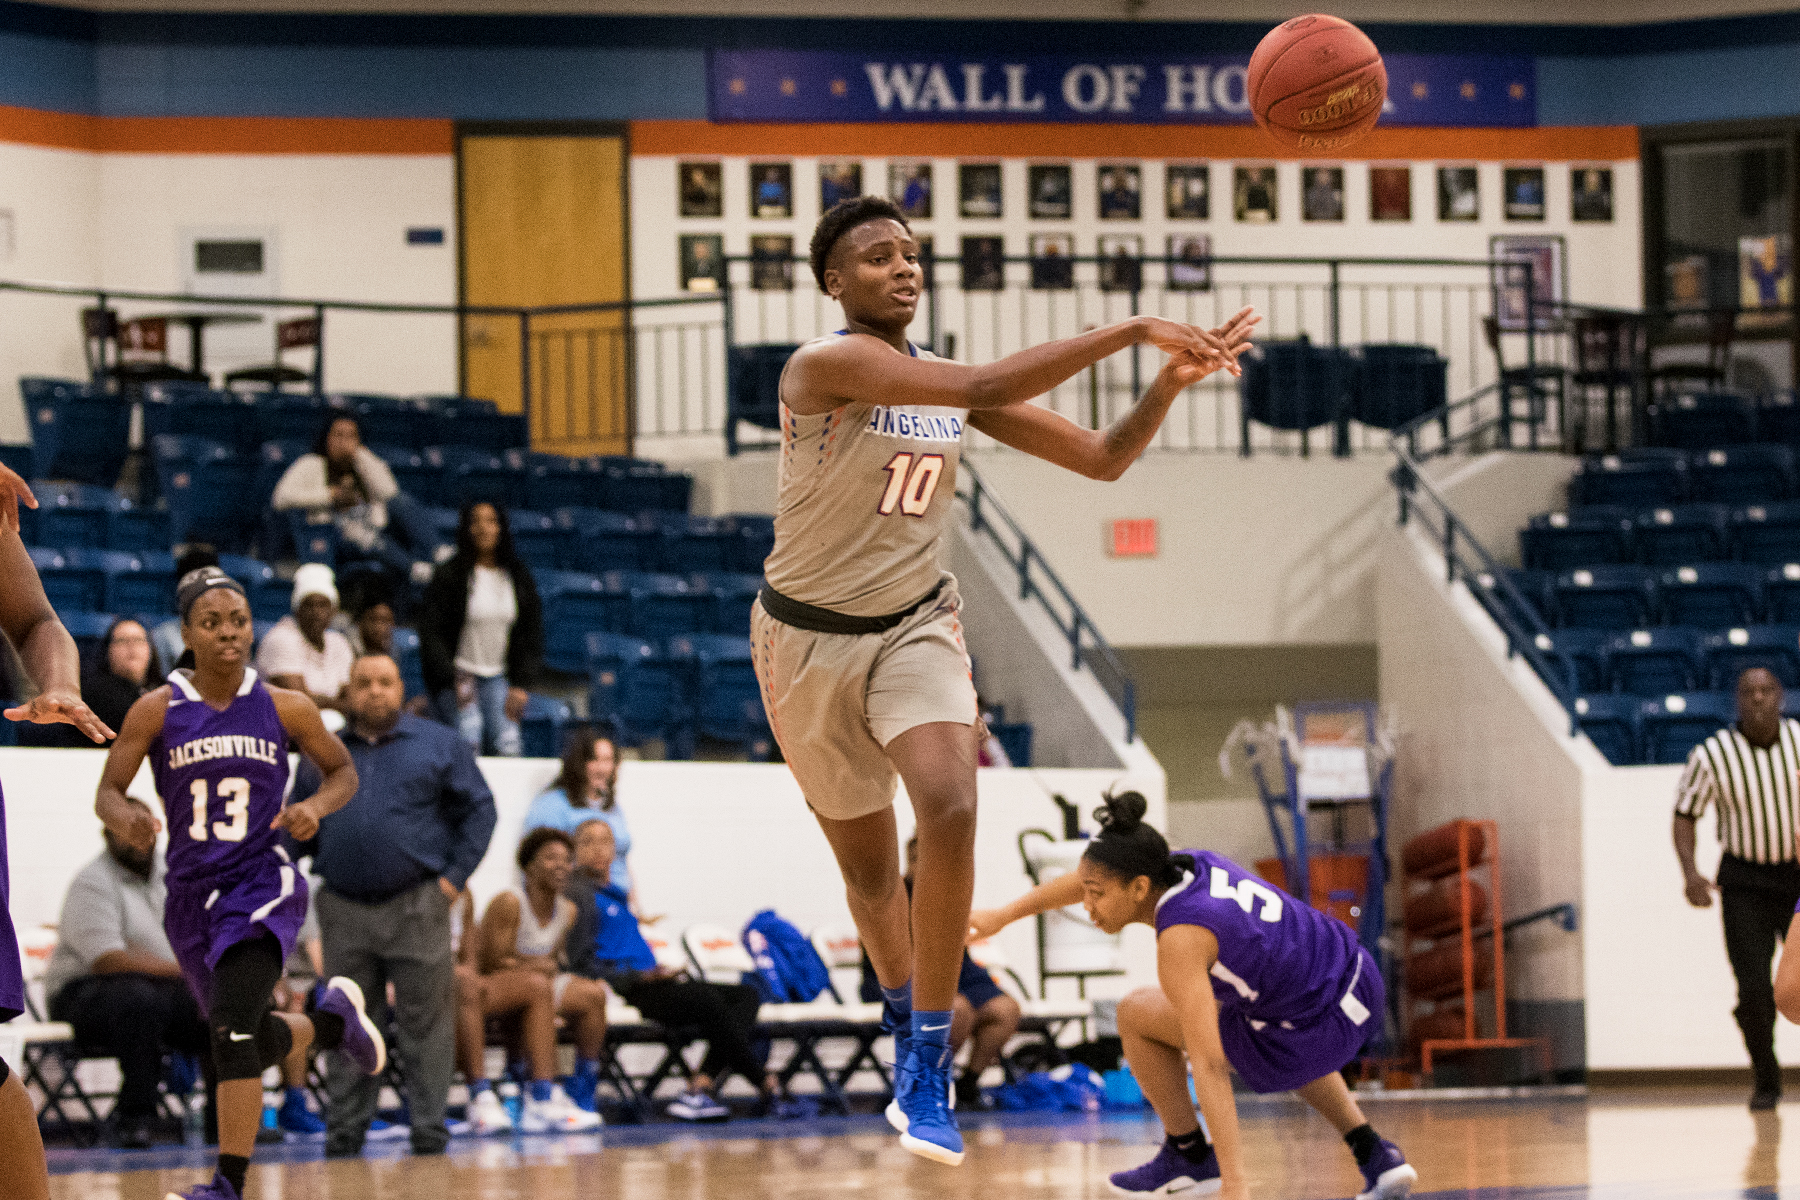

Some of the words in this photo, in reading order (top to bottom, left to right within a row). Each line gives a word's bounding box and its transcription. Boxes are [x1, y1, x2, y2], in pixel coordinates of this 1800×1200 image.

[864, 62, 1046, 112] WALL
[1060, 63, 1146, 113] OF
[864, 405, 963, 442] ANGELINA
[877, 451, 945, 518] 10
[168, 735, 278, 770] JACKSONVILLE
[188, 777, 251, 842] 13
[1210, 866, 1283, 923] 5
